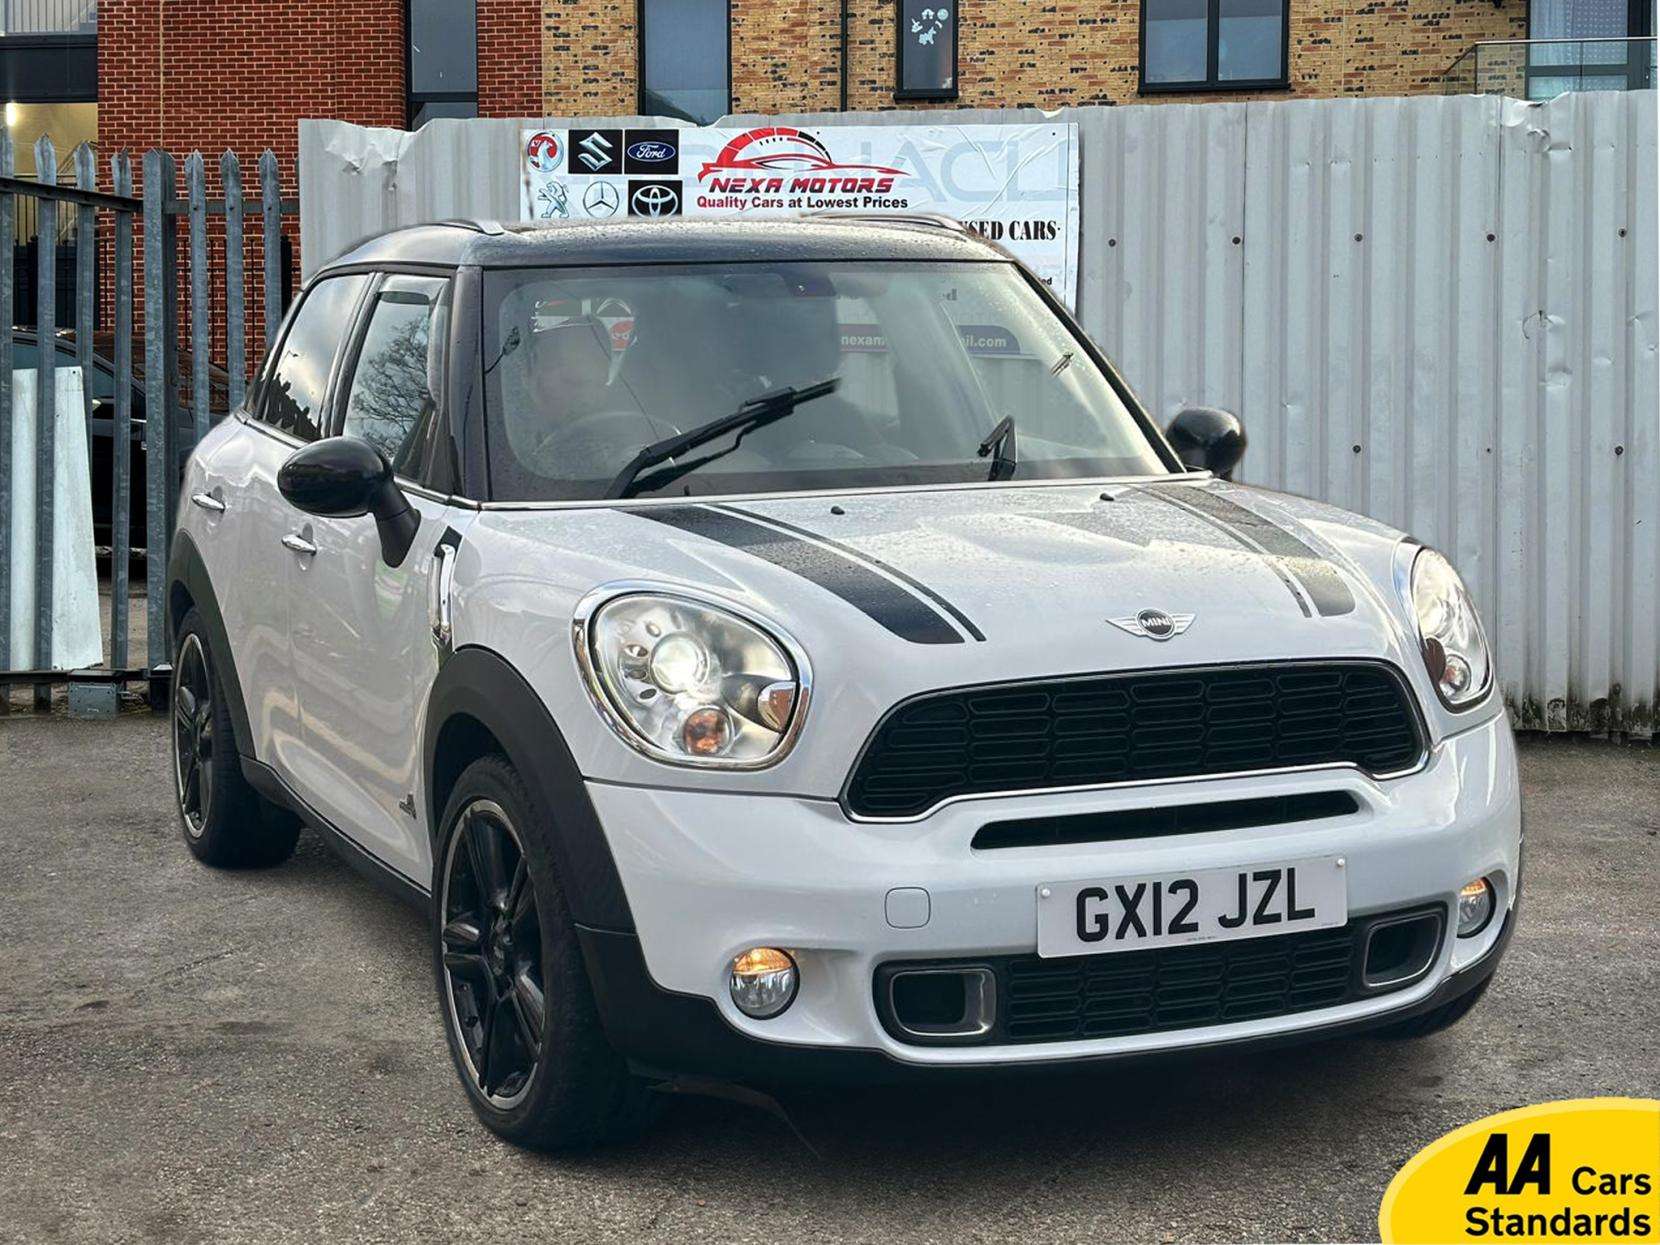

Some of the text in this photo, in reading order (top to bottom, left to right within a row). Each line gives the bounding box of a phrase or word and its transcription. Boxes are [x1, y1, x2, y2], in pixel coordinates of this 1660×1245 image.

[636, 143, 666, 158] Ford
[708, 177, 895, 193] NEXA MOTORS
[696, 195, 908, 211] Quality Cars at Lowest Prices
[1008, 220, 1057, 241] CARS
[1140, 616, 1172, 627] MINI
[1075, 867, 1316, 943] GX12 JZL
